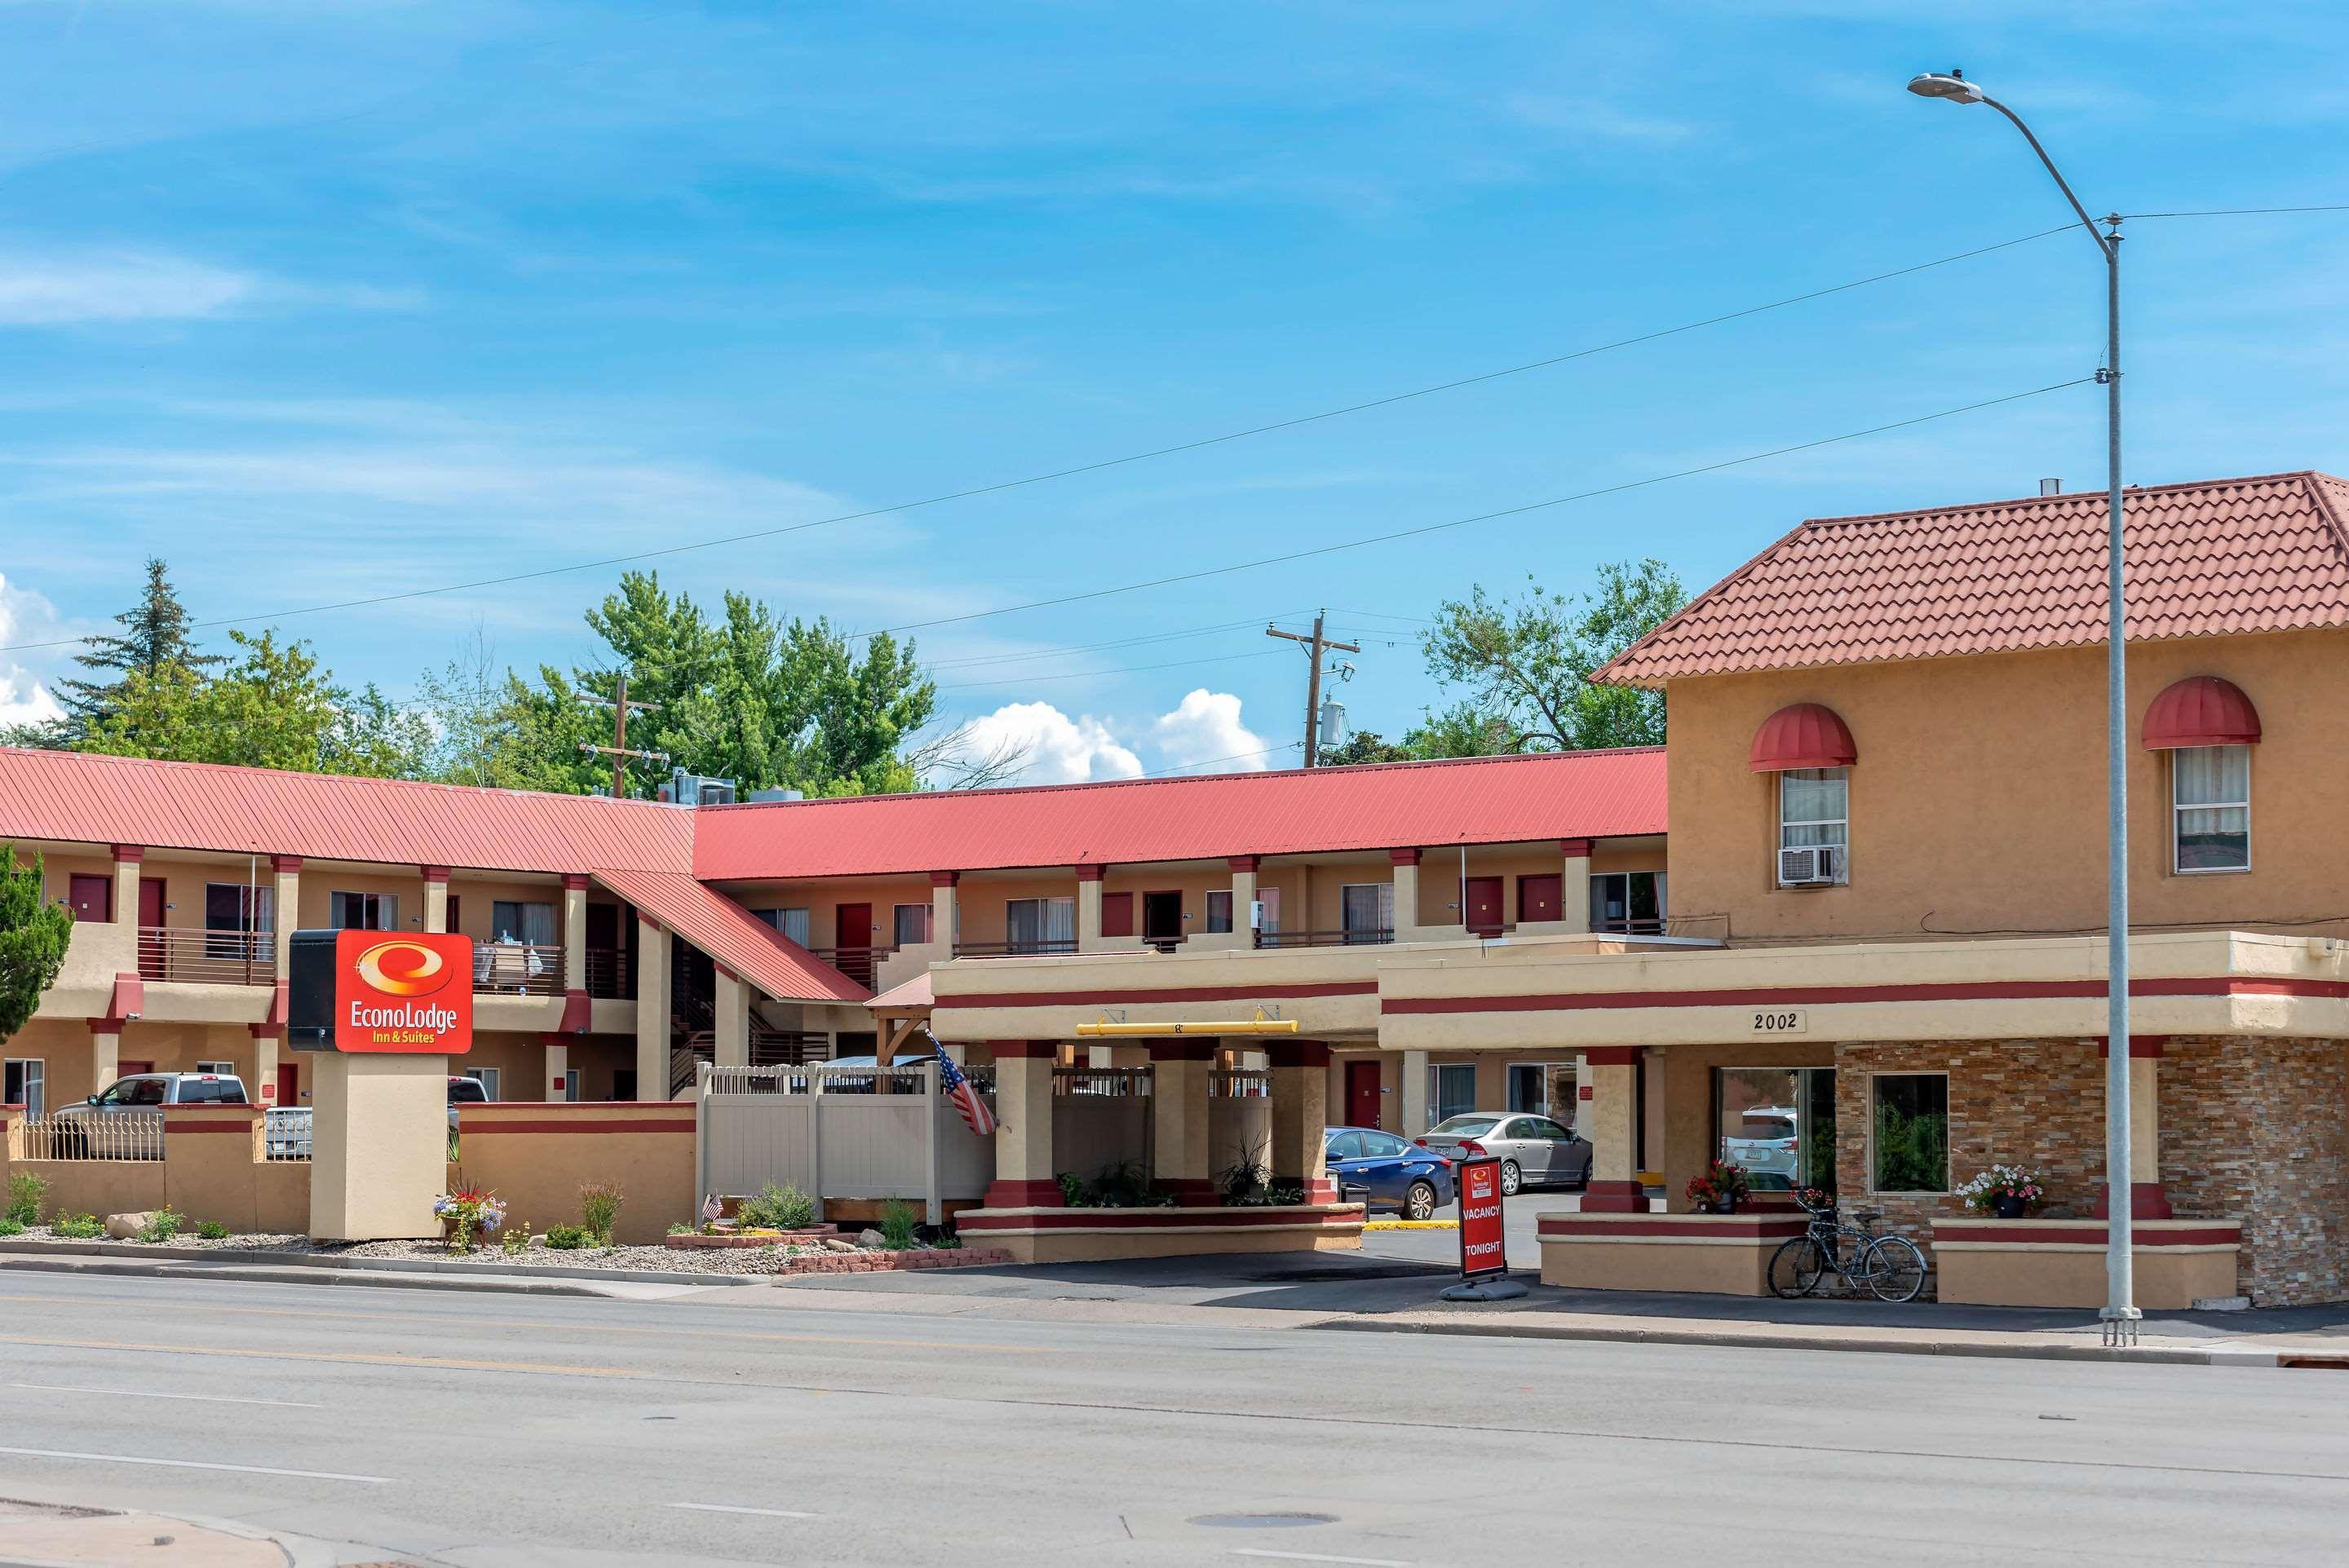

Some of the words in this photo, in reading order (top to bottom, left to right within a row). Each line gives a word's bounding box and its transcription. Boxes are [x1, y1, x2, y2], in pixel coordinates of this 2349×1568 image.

[351, 1000, 458, 1035] EconoLodge
[1754, 1014, 1797, 1030] 2002
[373, 1031, 391, 1043] Inn
[392, 1031, 401, 1044] &
[402, 1031, 435, 1045] Suites
[1462, 1205, 1501, 1221] VACANCY
[1465, 1241, 1501, 1257] TONIGHT
